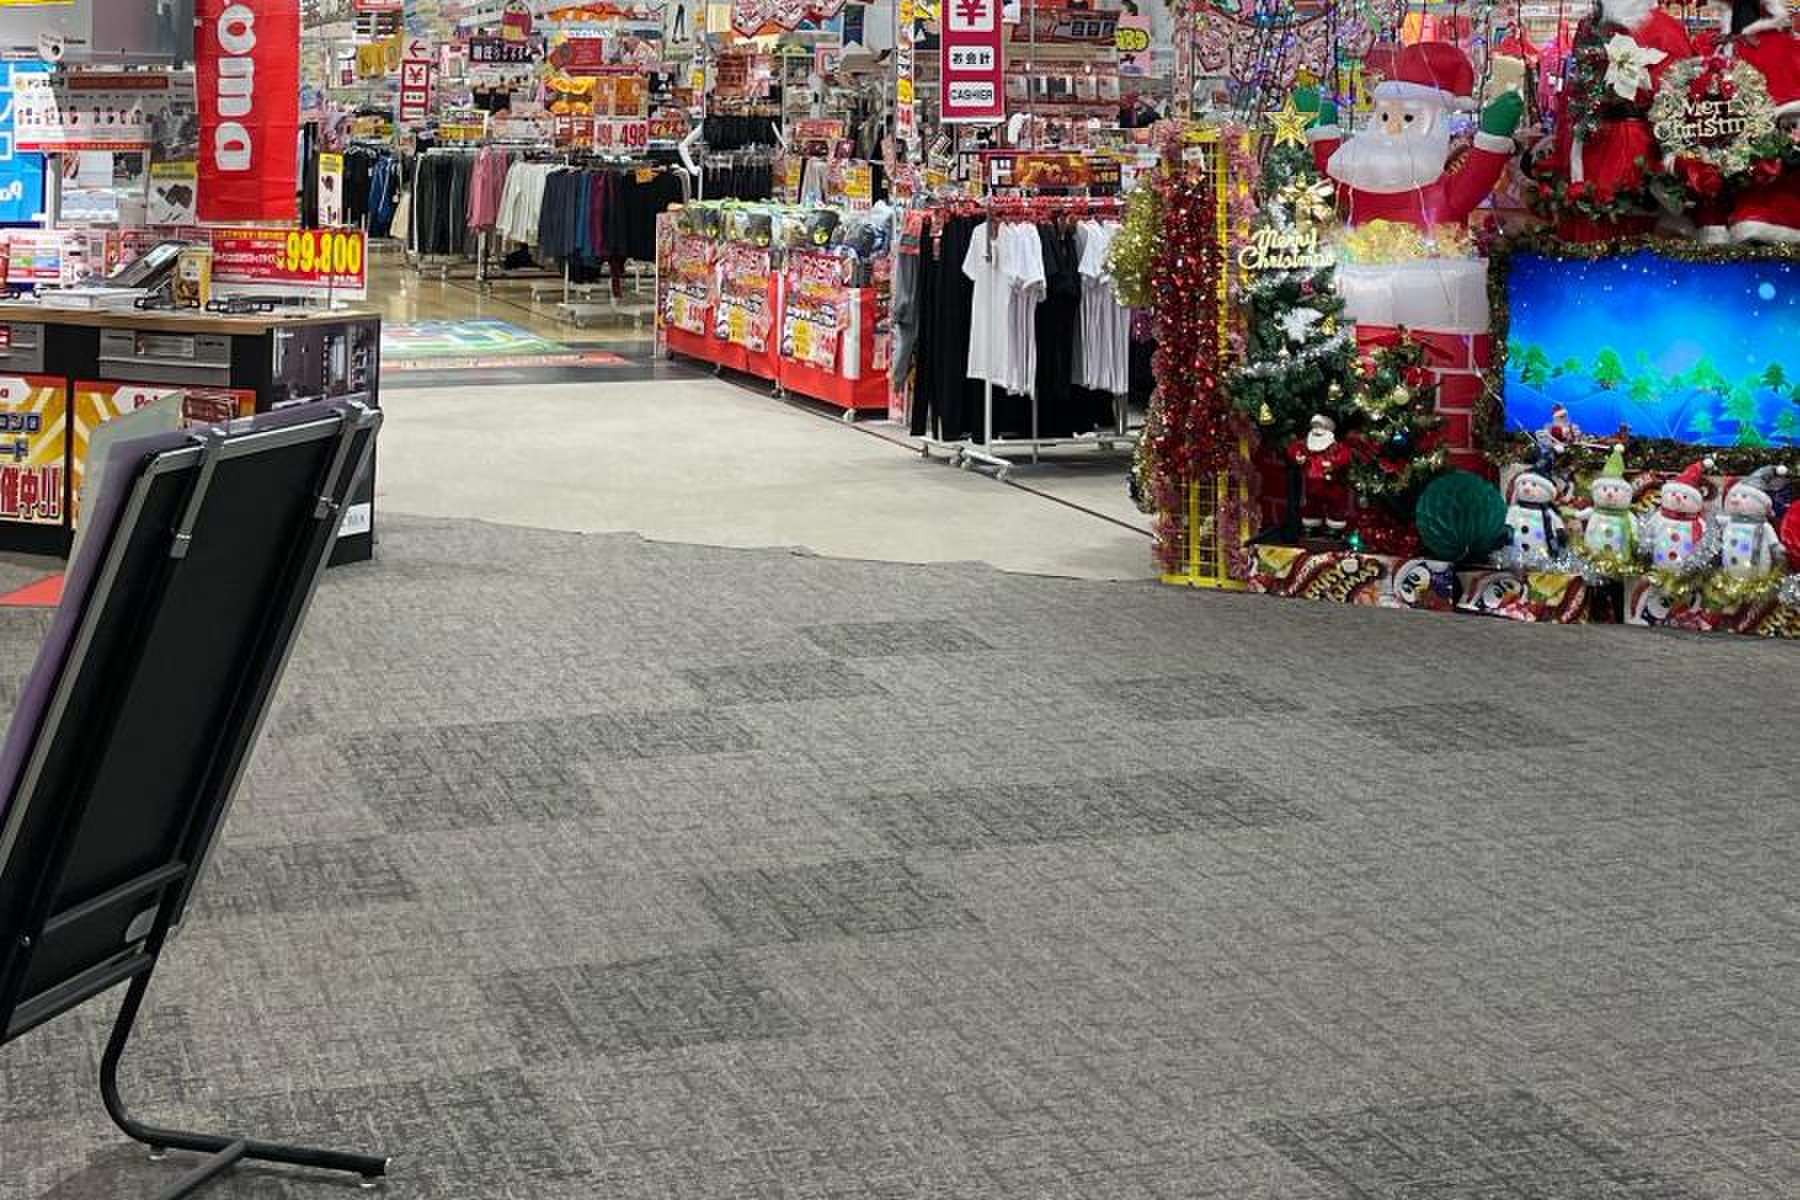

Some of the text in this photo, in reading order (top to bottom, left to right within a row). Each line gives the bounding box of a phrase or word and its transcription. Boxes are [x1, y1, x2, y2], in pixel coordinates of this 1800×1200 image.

[951, 52, 992, 66] お会計
[949, 90, 993, 102] CASHIER
[1250, 223, 1319, 254] Merry
[1238, 245, 1337, 271] Christmas
